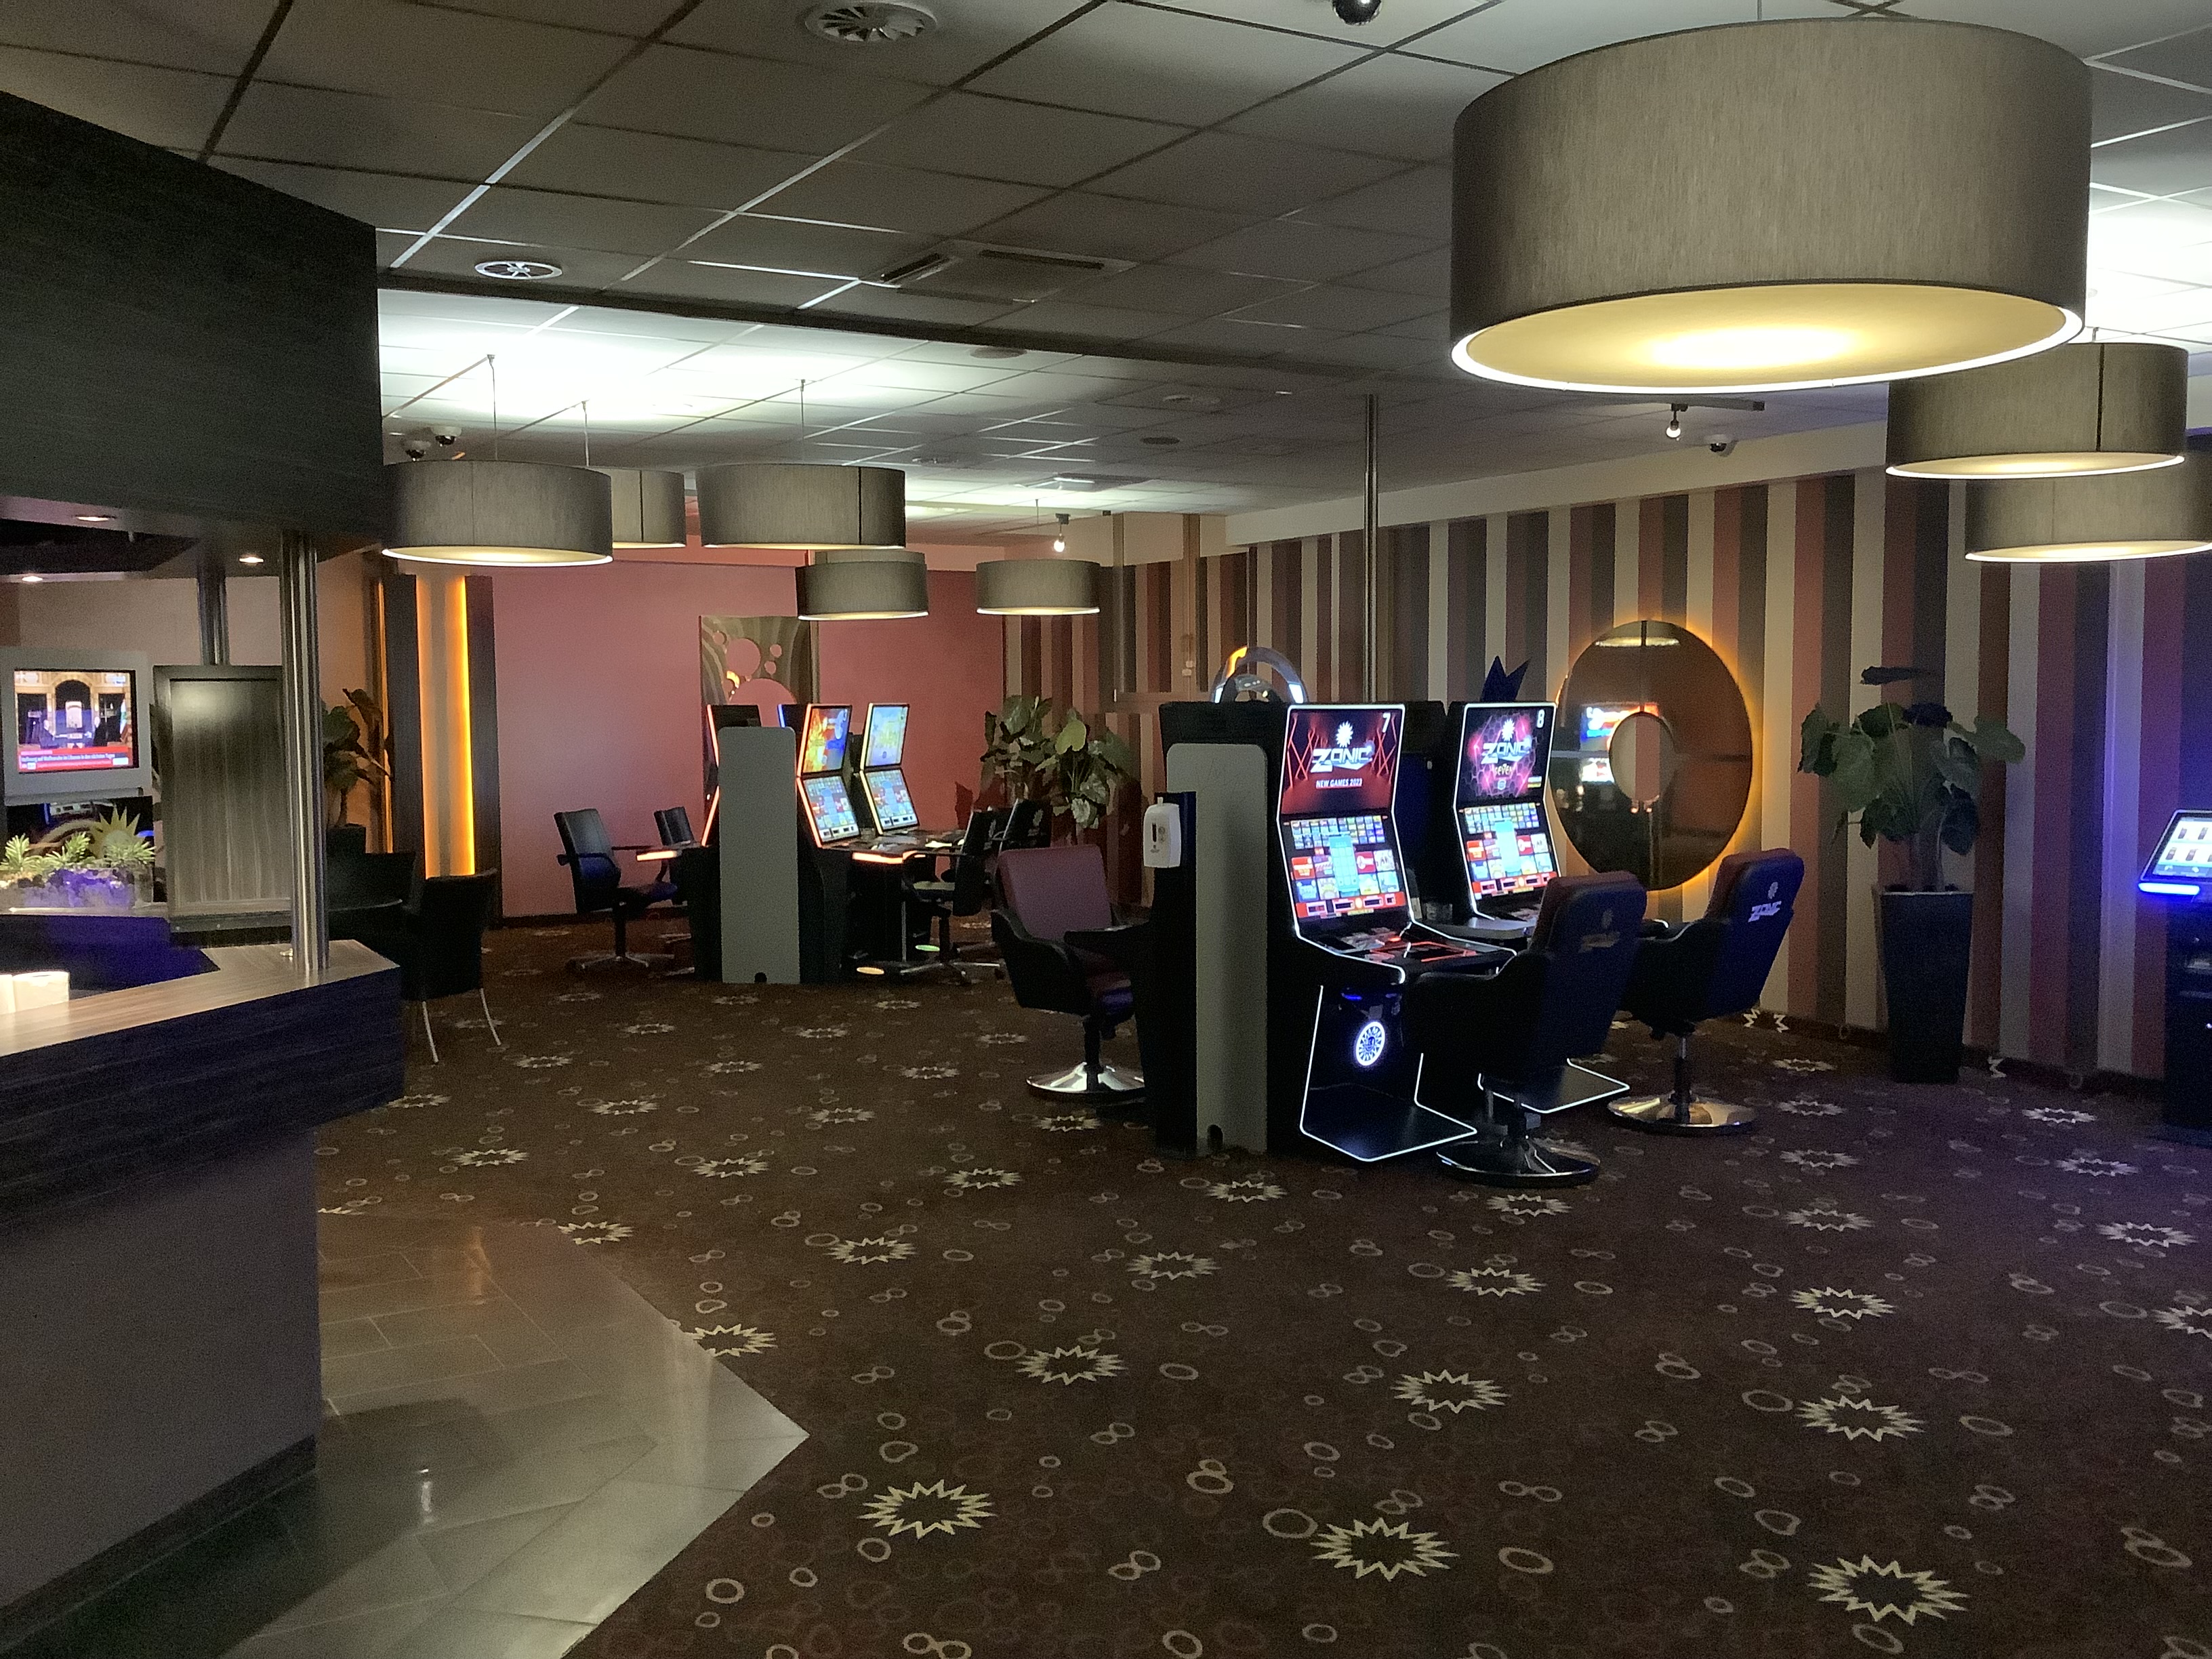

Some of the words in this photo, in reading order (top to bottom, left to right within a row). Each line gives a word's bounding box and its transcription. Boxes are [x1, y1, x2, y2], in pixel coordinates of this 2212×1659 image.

[1382, 712, 1391, 733] 7
[1536, 709, 1544, 729] 8
[1310, 747, 1372, 773] ZONIC
[1481, 741, 1530, 764] ZONIC
[1316, 780, 1330, 788] NEW
[1330, 779, 1349, 787] GAMES
